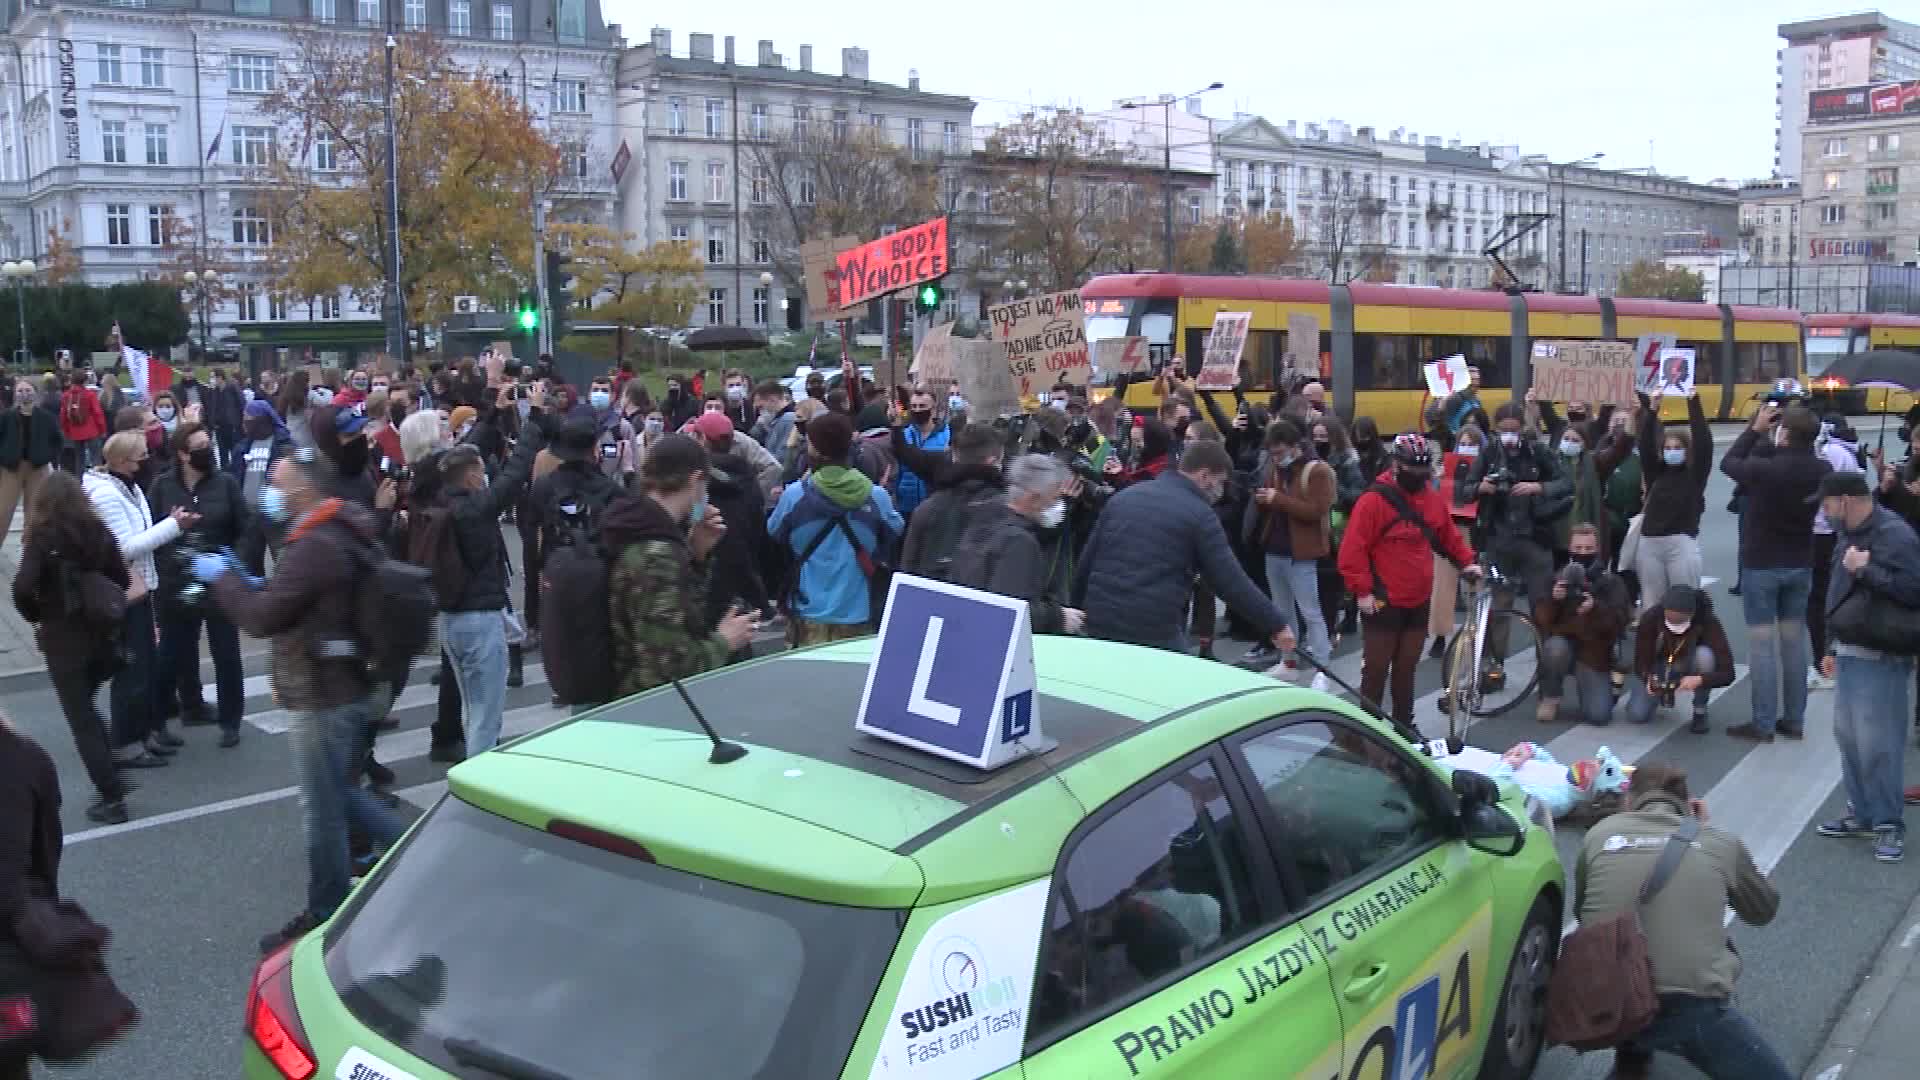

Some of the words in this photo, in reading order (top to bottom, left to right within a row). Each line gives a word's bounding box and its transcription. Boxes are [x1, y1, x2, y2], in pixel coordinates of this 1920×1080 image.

[59, 40, 77, 105] INDIGO
[839, 254, 868, 300] MY
[891, 226, 938, 261] BODY
[867, 255, 942, 294] CHOICE
[907, 616, 962, 726] L
[1010, 701, 1025, 735] L
[901, 992, 973, 1038] SUSHI
[1112, 988, 1234, 1076] PRAWO
[1237, 932, 1315, 1005] JAZDY
[906, 1036, 946, 1065] Fast
[949, 1020, 980, 1050] and
[982, 1007, 1022, 1037] Tasty
